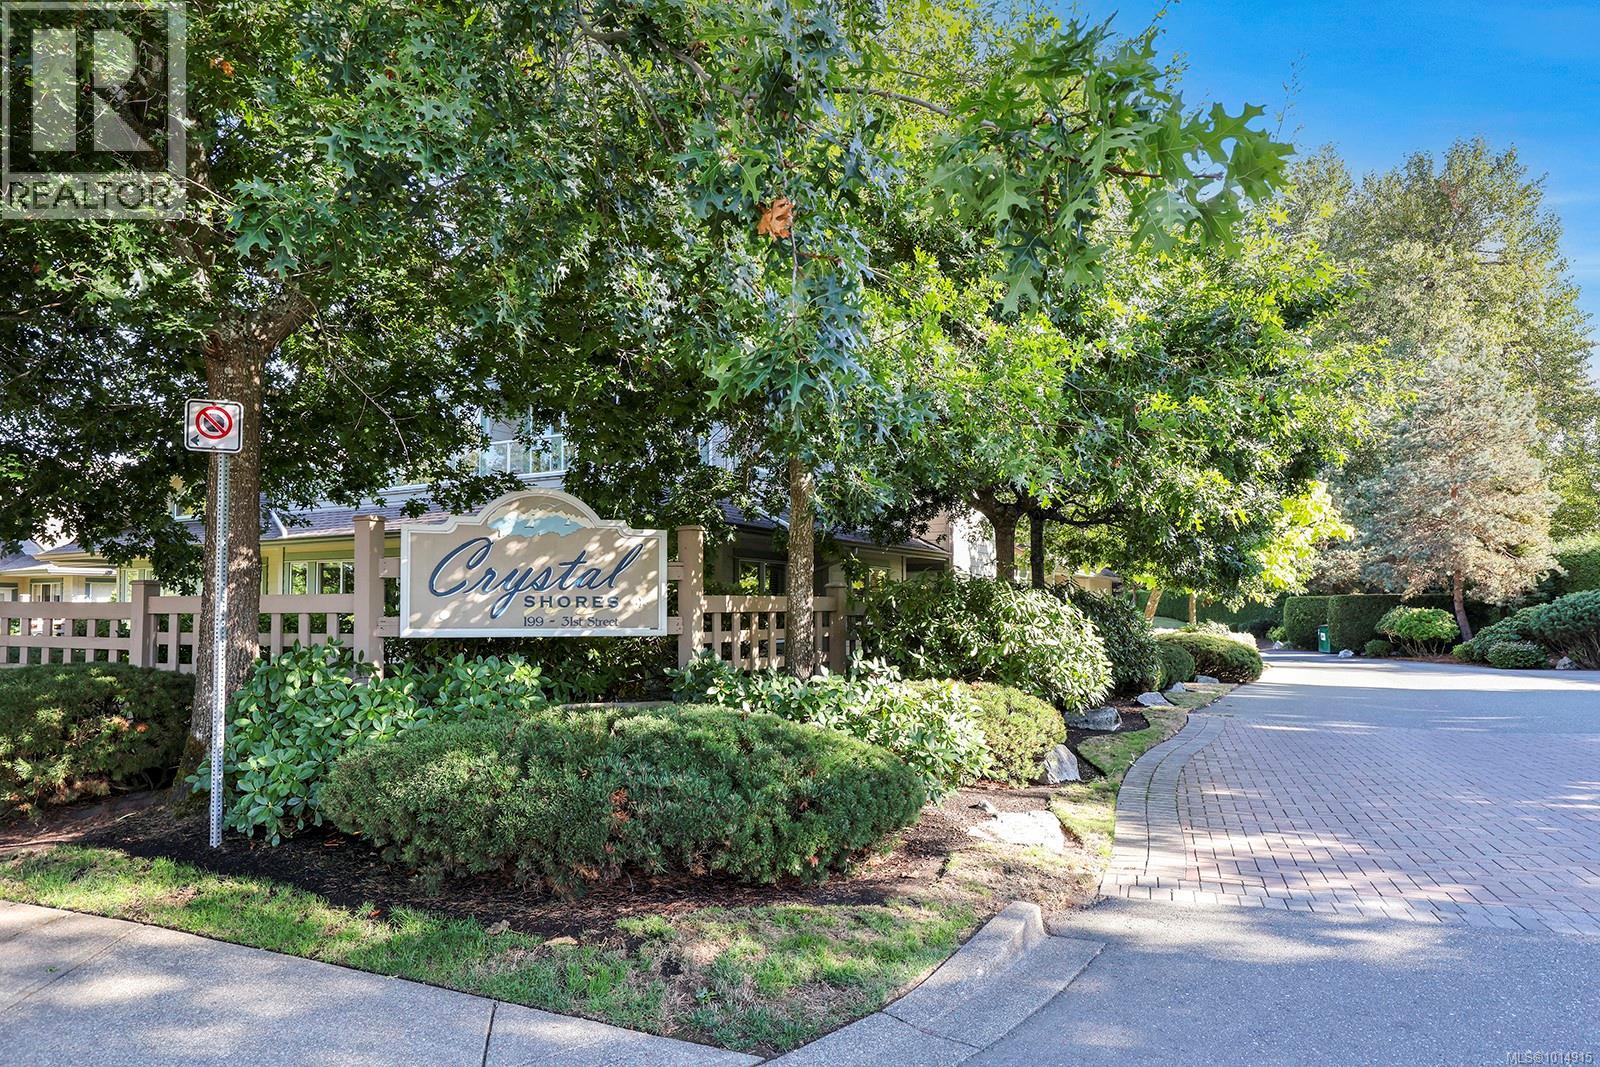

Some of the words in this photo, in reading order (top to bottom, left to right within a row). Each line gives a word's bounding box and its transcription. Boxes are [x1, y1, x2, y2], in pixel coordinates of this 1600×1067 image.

[429, 537, 644, 619] Crystal
[523, 595, 619, 609] SHORES
[523, 616, 544, 627] 199
[561, 616, 583, 627] 31st
[587, 616, 619, 627] Street
